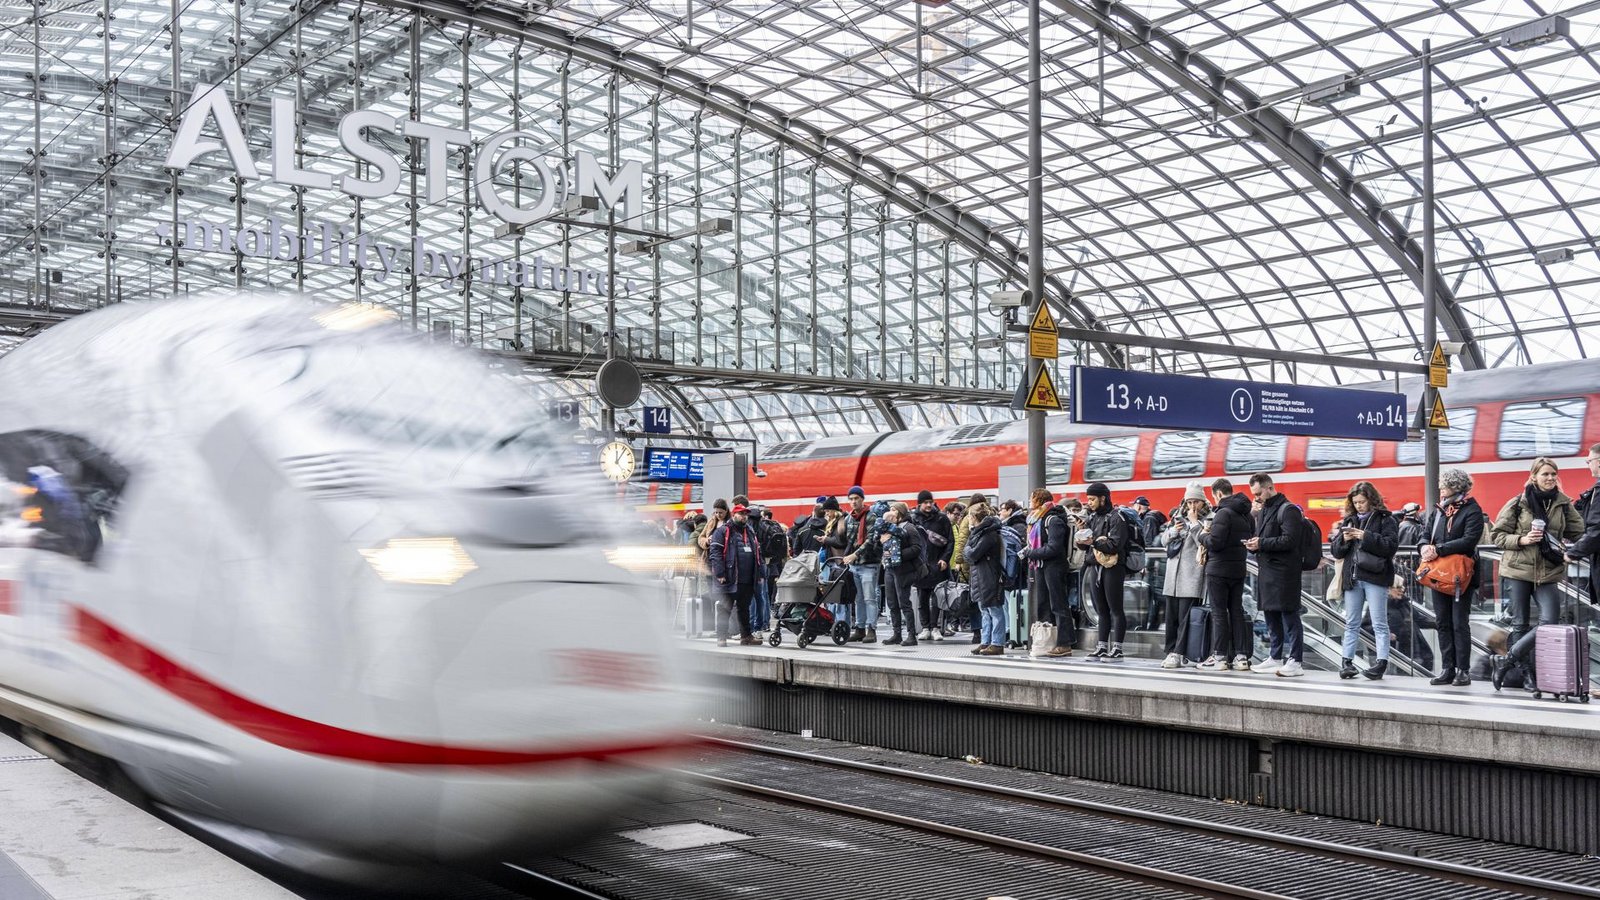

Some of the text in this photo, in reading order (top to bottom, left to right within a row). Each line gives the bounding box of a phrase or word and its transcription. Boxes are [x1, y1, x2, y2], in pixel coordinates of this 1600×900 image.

[164, 82, 644, 231] ALSTOM
[184, 216, 398, 283] mobility
[411, 236, 471, 290] by
[1106, 383, 1168, 412] 13 A-D
[554, 402, 573, 422] 13
[650, 408, 668, 427] 14
[1366, 405, 1404, 427] A-D 14
